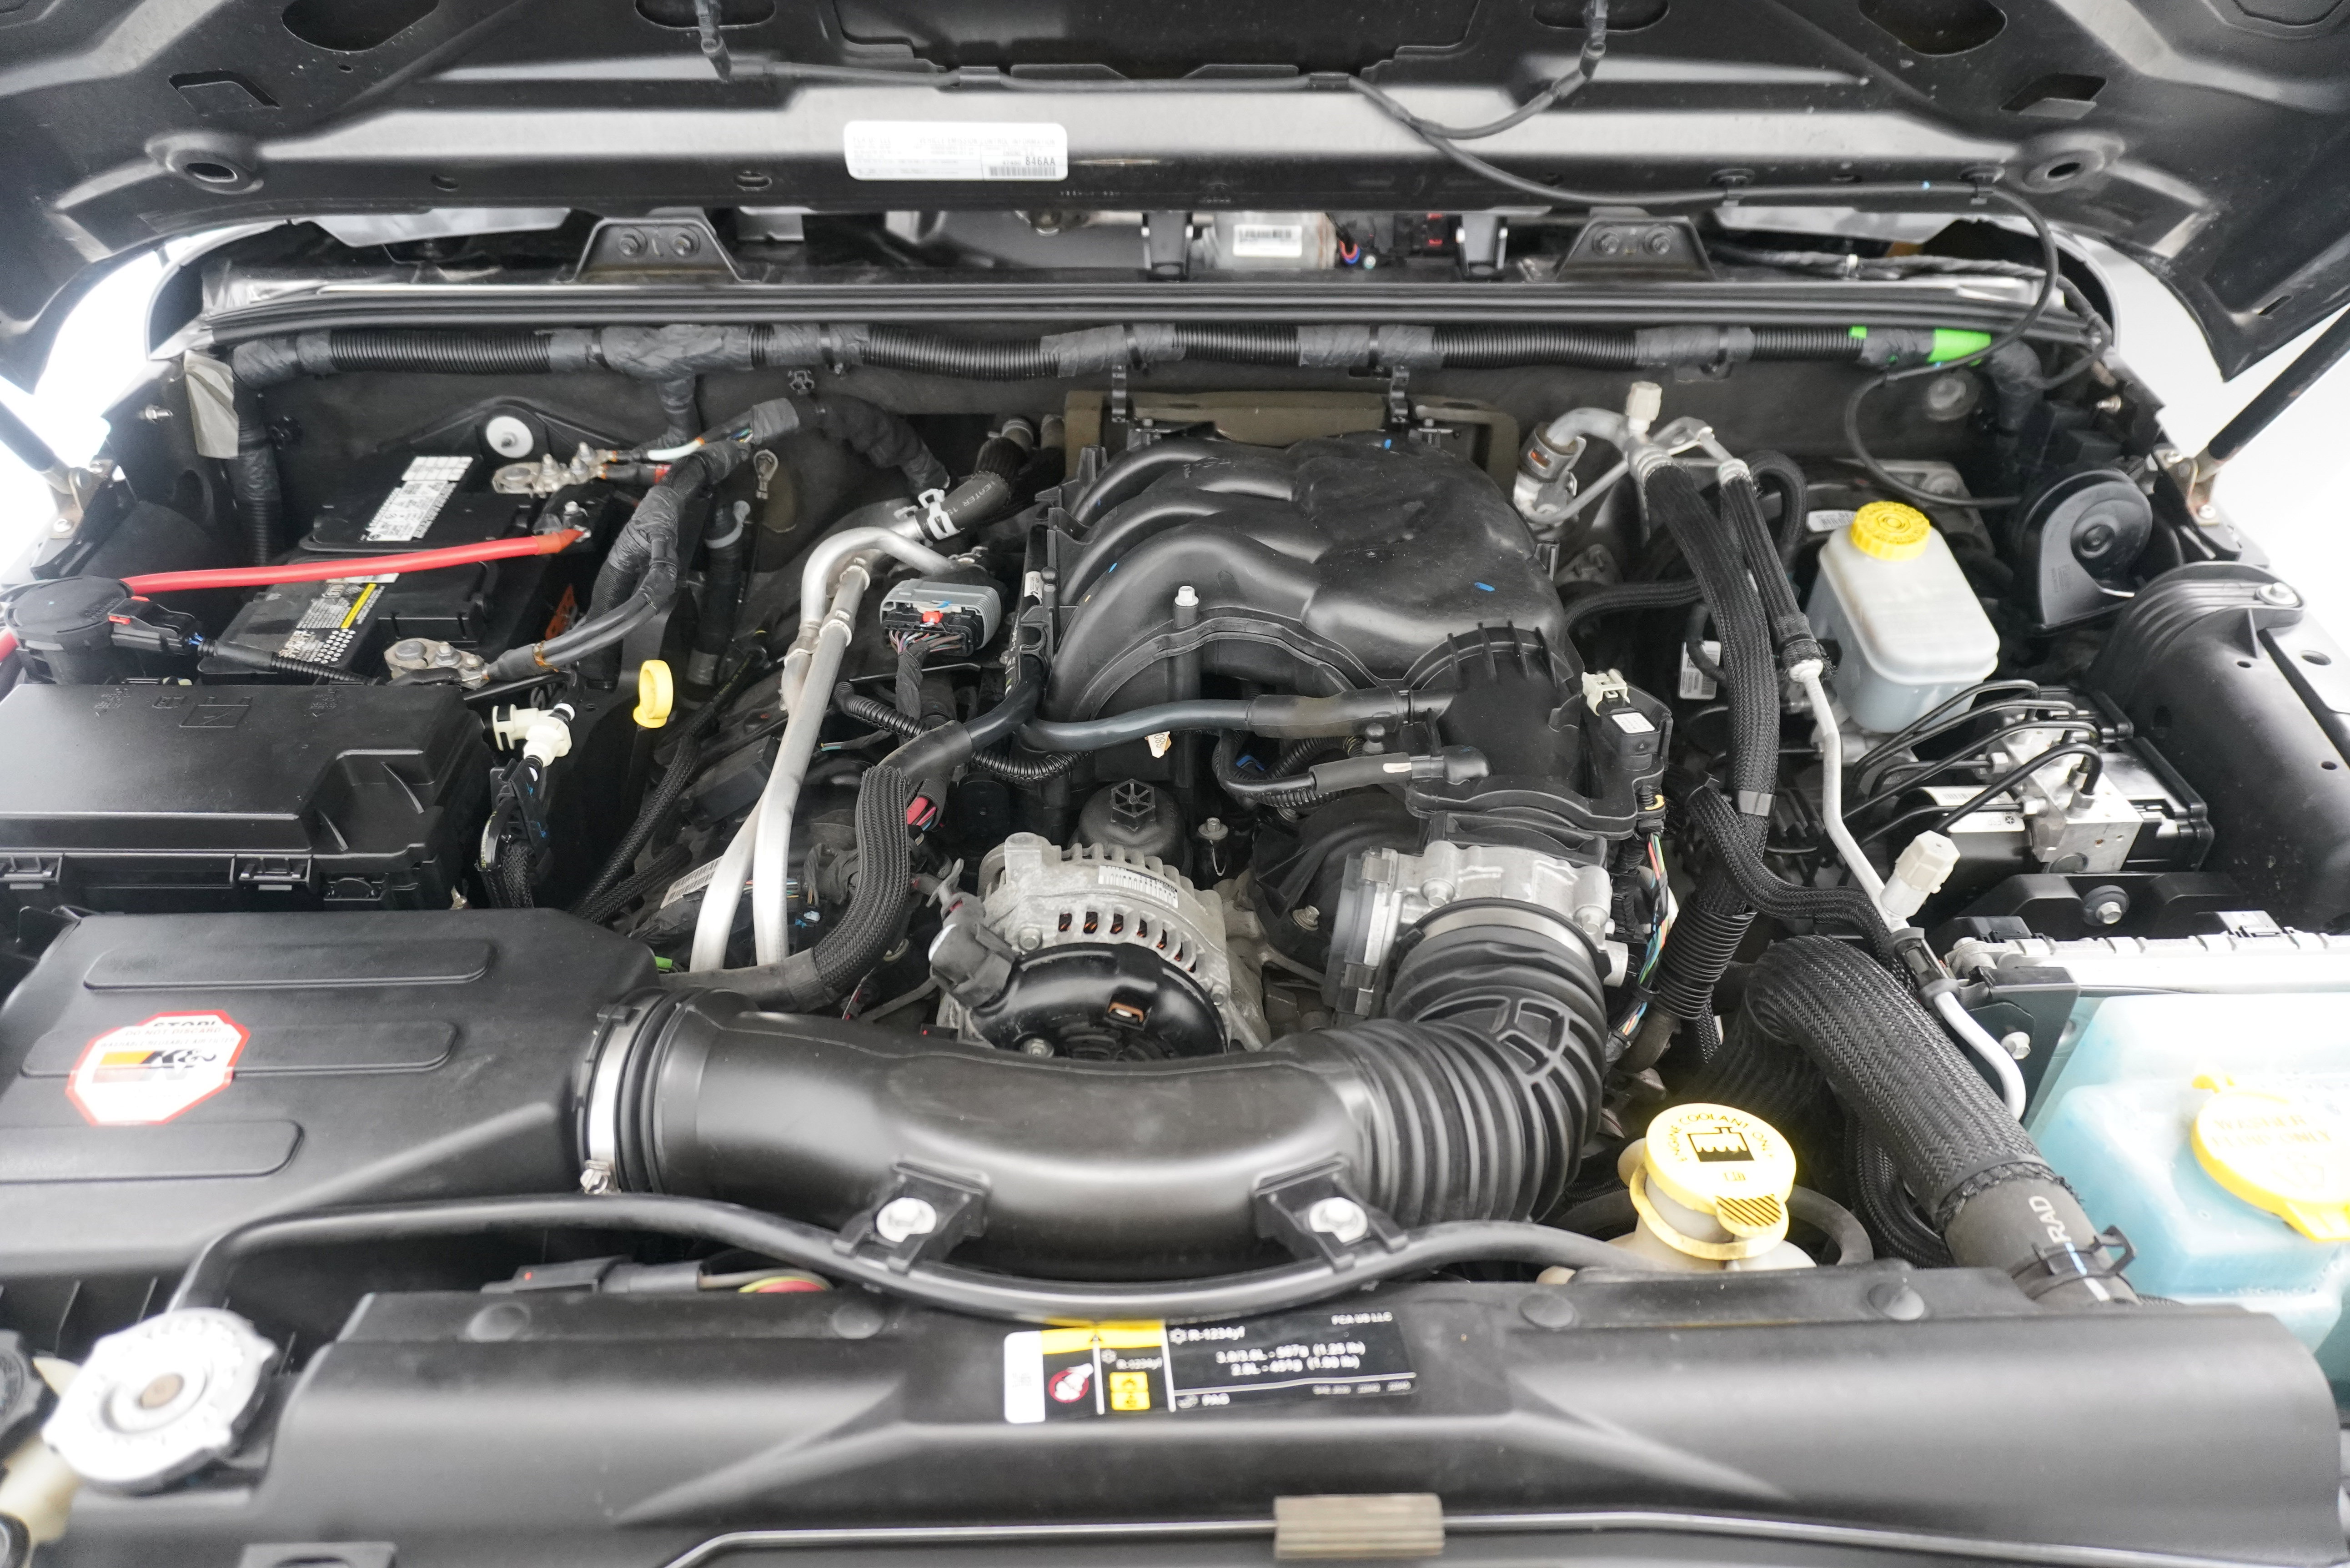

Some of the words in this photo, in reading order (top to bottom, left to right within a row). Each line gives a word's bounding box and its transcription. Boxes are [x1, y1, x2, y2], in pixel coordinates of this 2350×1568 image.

[1025, 156, 1056, 166] 846AA
[962, 480, 996, 507] HEATER
[171, 1027, 221, 1035] DISCARD
[1679, 1113, 1749, 1129] COOLANT
[2213, 1115, 2307, 1130] WASHER
[2211, 1134, 2271, 1147] FLUID
[2280, 1129, 2332, 1143] ONLY
[2028, 1196, 2072, 1244] RAD
[1331, 1314, 1355, 1325] FCA
[1354, 1313, 1371, 1324] US
[1371, 1312, 1393, 1322] LLC
[1188, 1325, 1245, 1342] R-1234yf
[1346, 1341, 1366, 1356] lb)
[1116, 1357, 1163, 1370] R-1234yf
[1340, 1354, 1360, 1369] lb)
[1202, 1392, 1230, 1406] PAG
